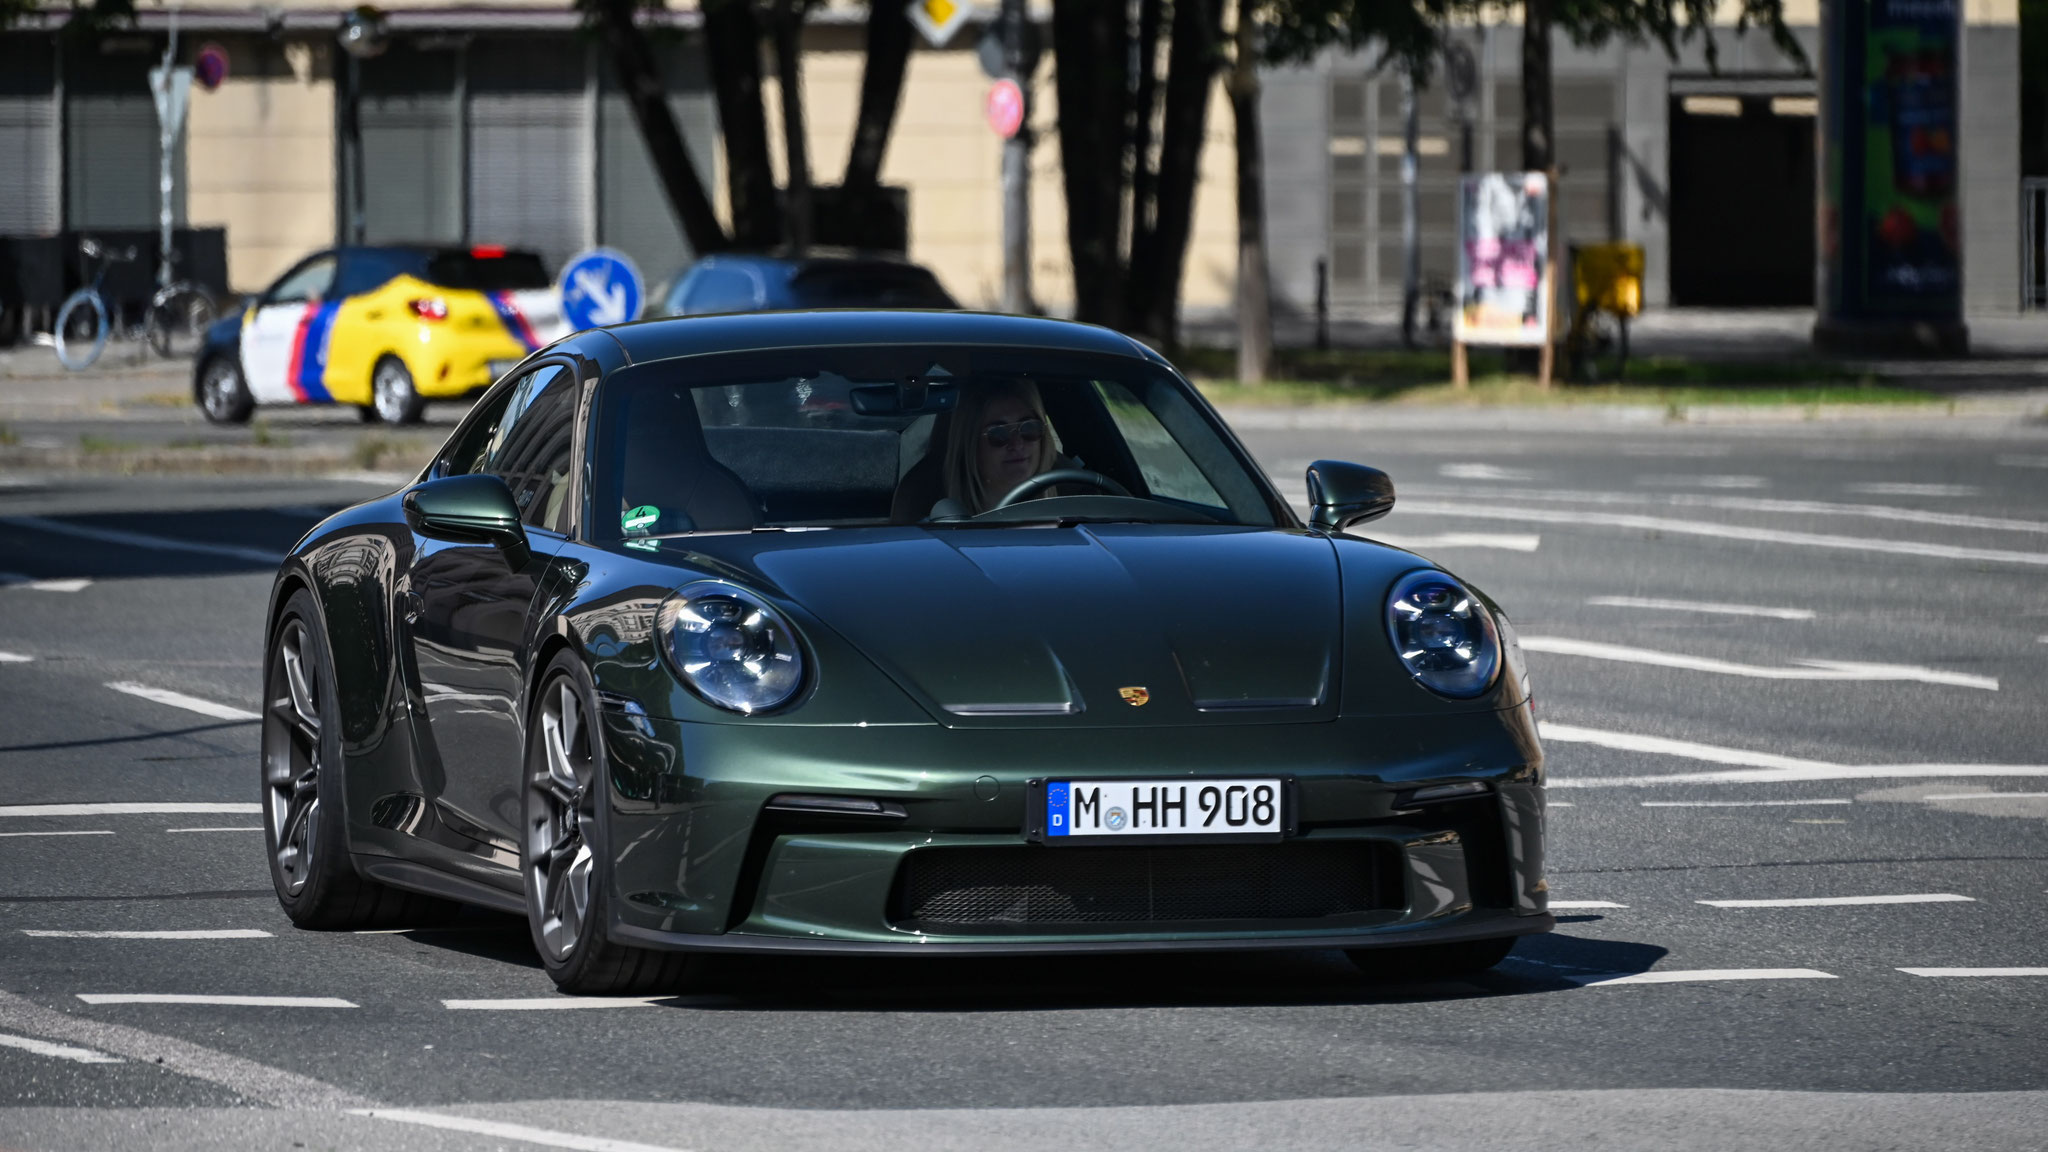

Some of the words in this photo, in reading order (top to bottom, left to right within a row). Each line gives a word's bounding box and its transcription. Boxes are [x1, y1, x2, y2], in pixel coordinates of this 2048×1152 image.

[635, 506, 646, 518] 4
[1074, 786, 1100, 828] M
[1132, 786, 1187, 828] HH
[1198, 785, 1275, 827] 908
[1052, 814, 1062, 827] D
